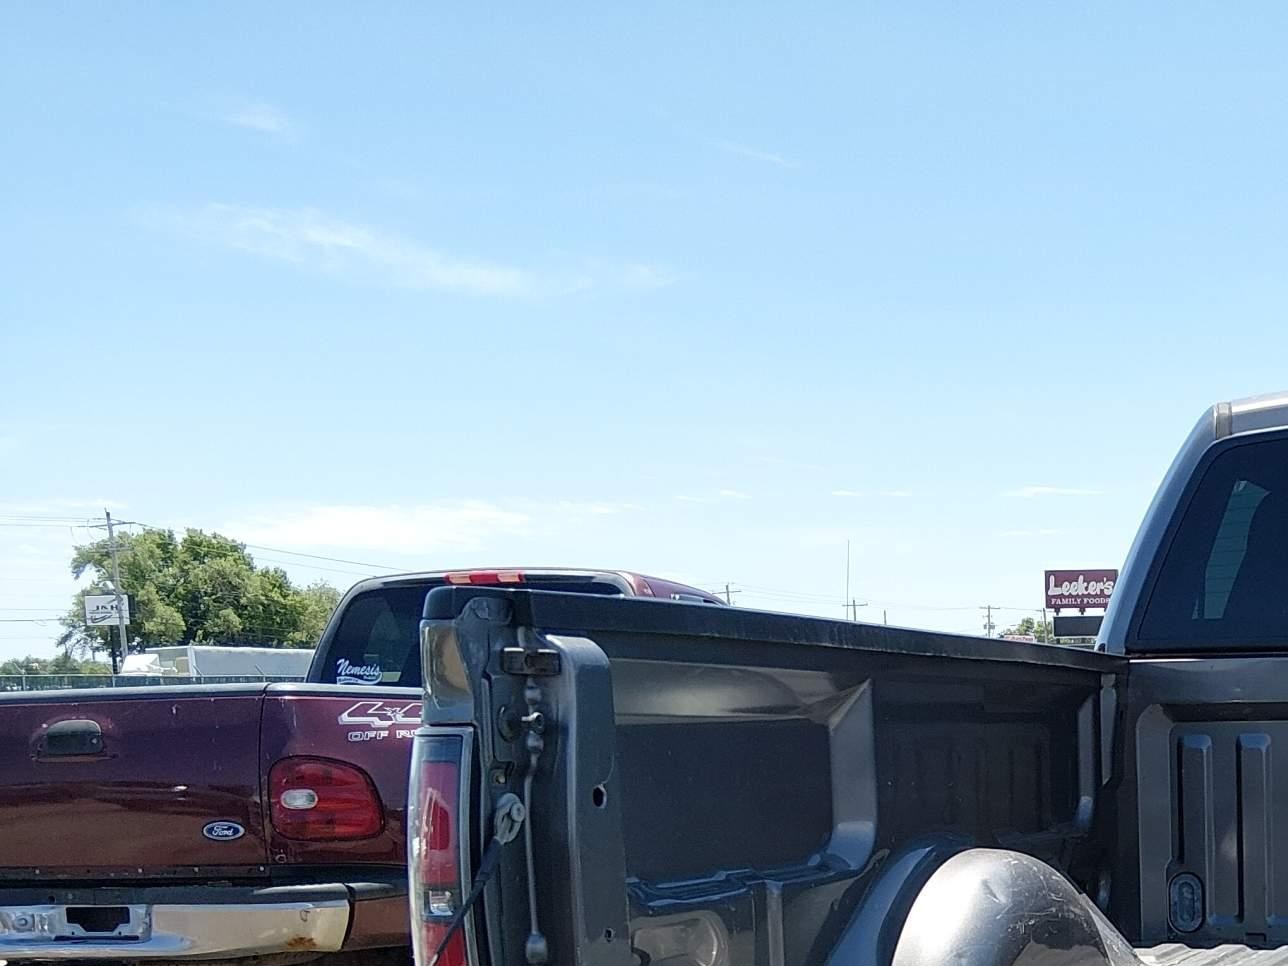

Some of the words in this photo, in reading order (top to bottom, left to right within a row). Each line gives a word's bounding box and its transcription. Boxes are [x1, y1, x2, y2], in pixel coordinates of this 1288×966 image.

[1047, 574, 1114, 596] Leeker's
[1051, 597, 1081, 605] FAMILY
[336, 658, 380, 676] Nemesis
[347, 730, 390, 742] OFF
